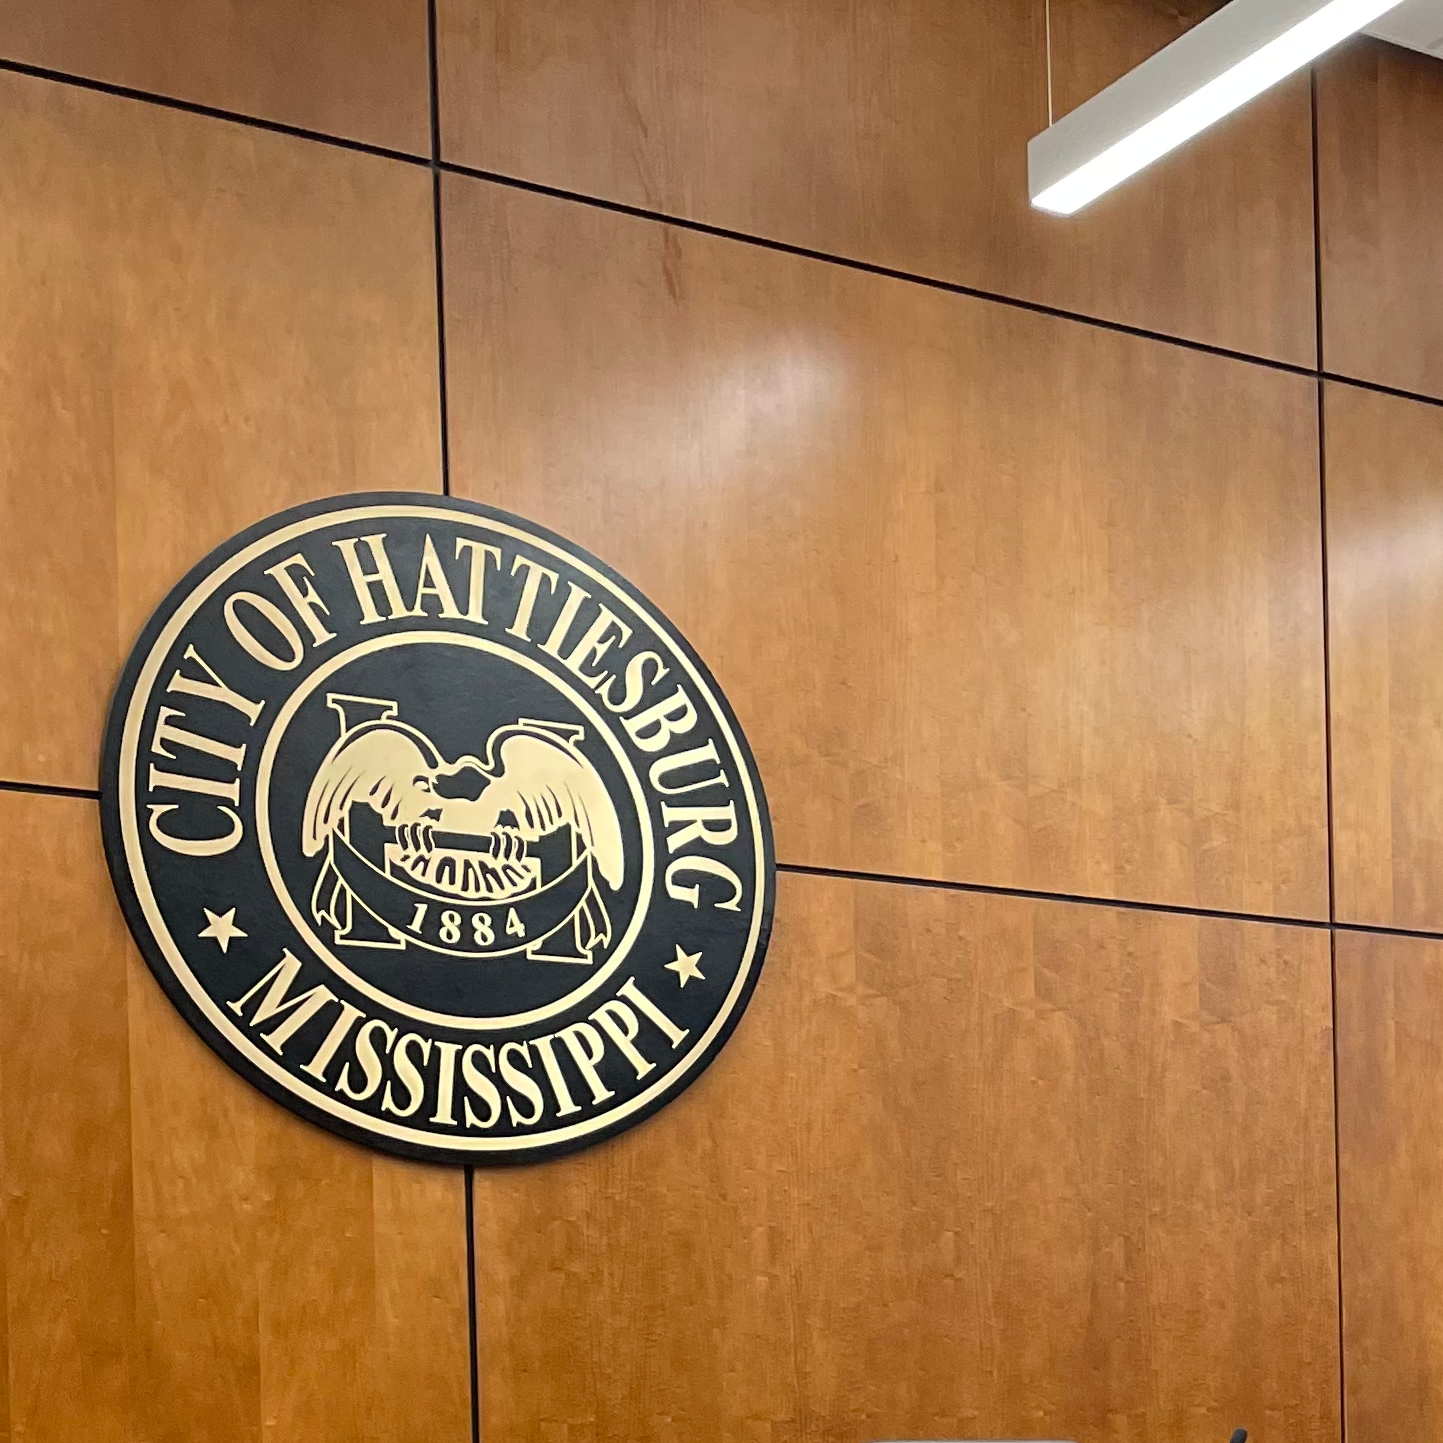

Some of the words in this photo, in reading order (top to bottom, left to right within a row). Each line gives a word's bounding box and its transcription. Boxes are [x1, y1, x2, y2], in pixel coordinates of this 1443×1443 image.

[147, 644, 265, 857] CITY
[223, 554, 337, 671] OF
[332, 533, 744, 912] HATTIESBURG
[407, 902, 526, 946] 1884
[226, 948, 690, 1129] MISSISSIPPI
